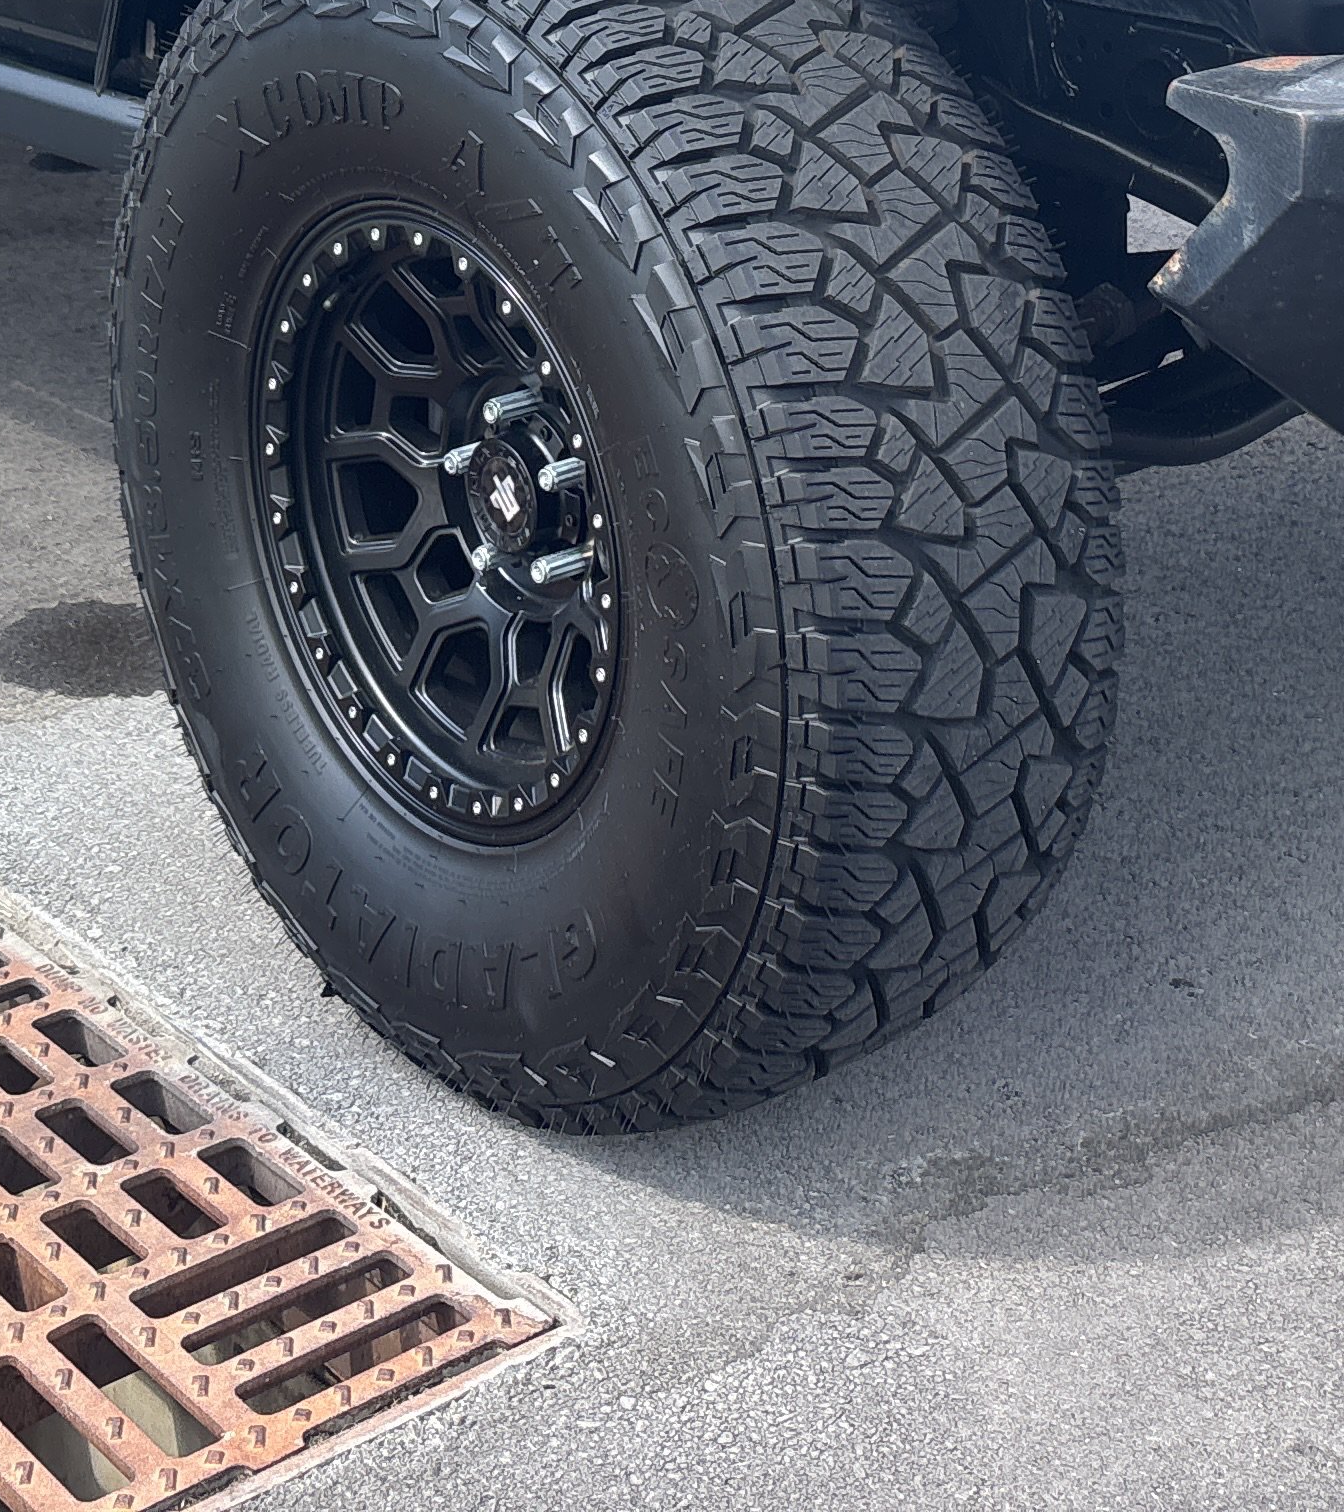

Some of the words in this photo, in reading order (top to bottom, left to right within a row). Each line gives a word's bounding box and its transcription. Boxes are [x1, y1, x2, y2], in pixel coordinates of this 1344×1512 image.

[245, 607, 281, 682] RADIAL
[274, 688, 328, 776] TUBELESS
[77, 996, 108, 1015] NO
[178, 1073, 250, 1122] DRAINS
[248, 1124, 278, 1144] TO
[278, 1146, 391, 1231] WATERWAYS
